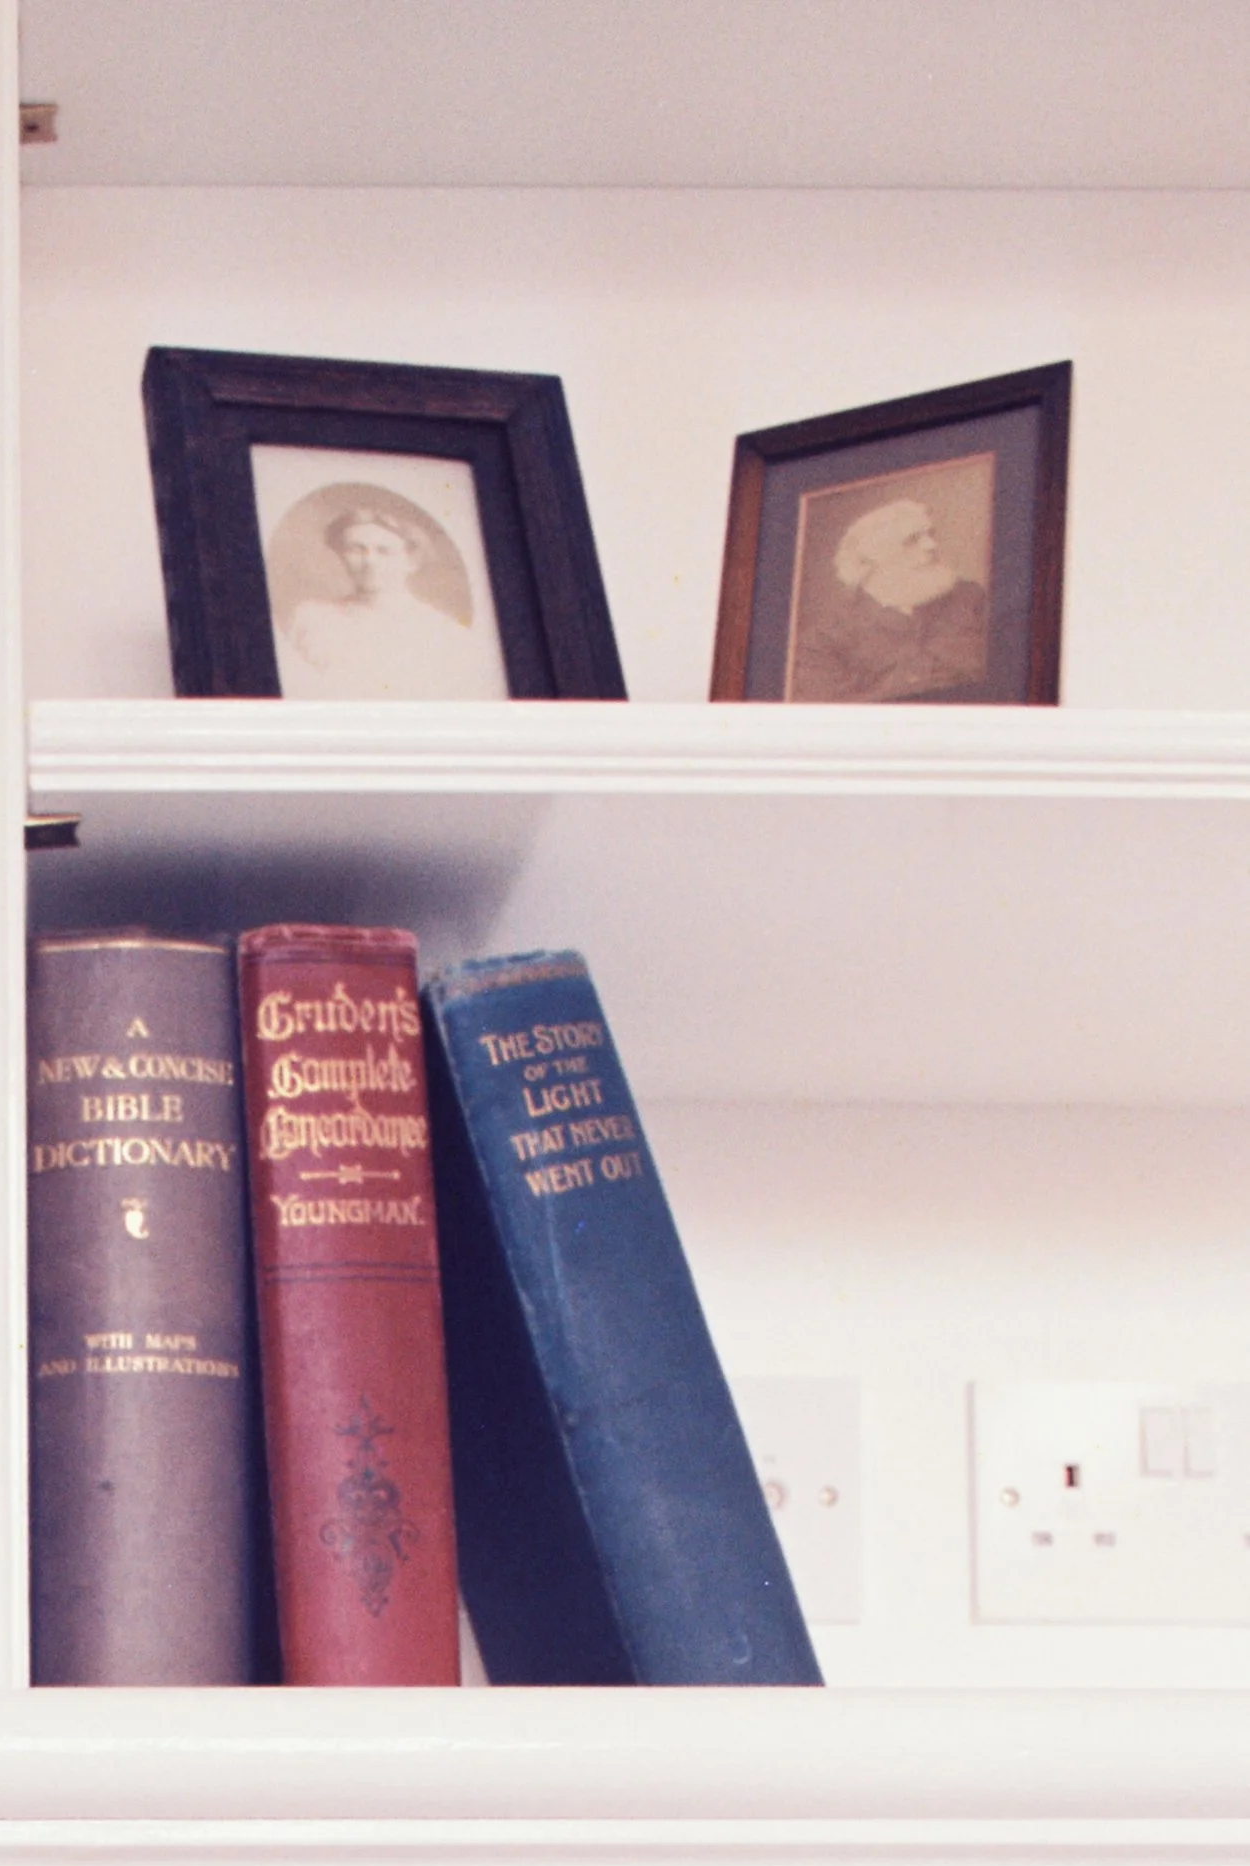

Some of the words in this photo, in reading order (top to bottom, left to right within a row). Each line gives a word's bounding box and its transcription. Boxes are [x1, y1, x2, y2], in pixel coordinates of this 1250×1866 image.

[125, 1016, 149, 1039] A
[480, 1033, 533, 1065] THE
[38, 1054, 99, 1085] NEW
[101, 1056, 127, 1080] &
[128, 1054, 234, 1086] CONCISE
[524, 1063, 546, 1082] OF
[554, 1057, 587, 1075] THE
[82, 1094, 185, 1123] BIBLE
[523, 1080, 602, 1118] LIGHT
[33, 1138, 237, 1173] DICTIONARY
[511, 1124, 565, 1161] THAT
[525, 1159, 593, 1197] WENT
[601, 1152, 643, 1180] OUT
[85, 1331, 134, 1351] WITH
[145, 1332, 197, 1351] MAPS
[39, 1357, 77, 1378] AND
[85, 1353, 240, 1379] ILLUSTRATIONS
